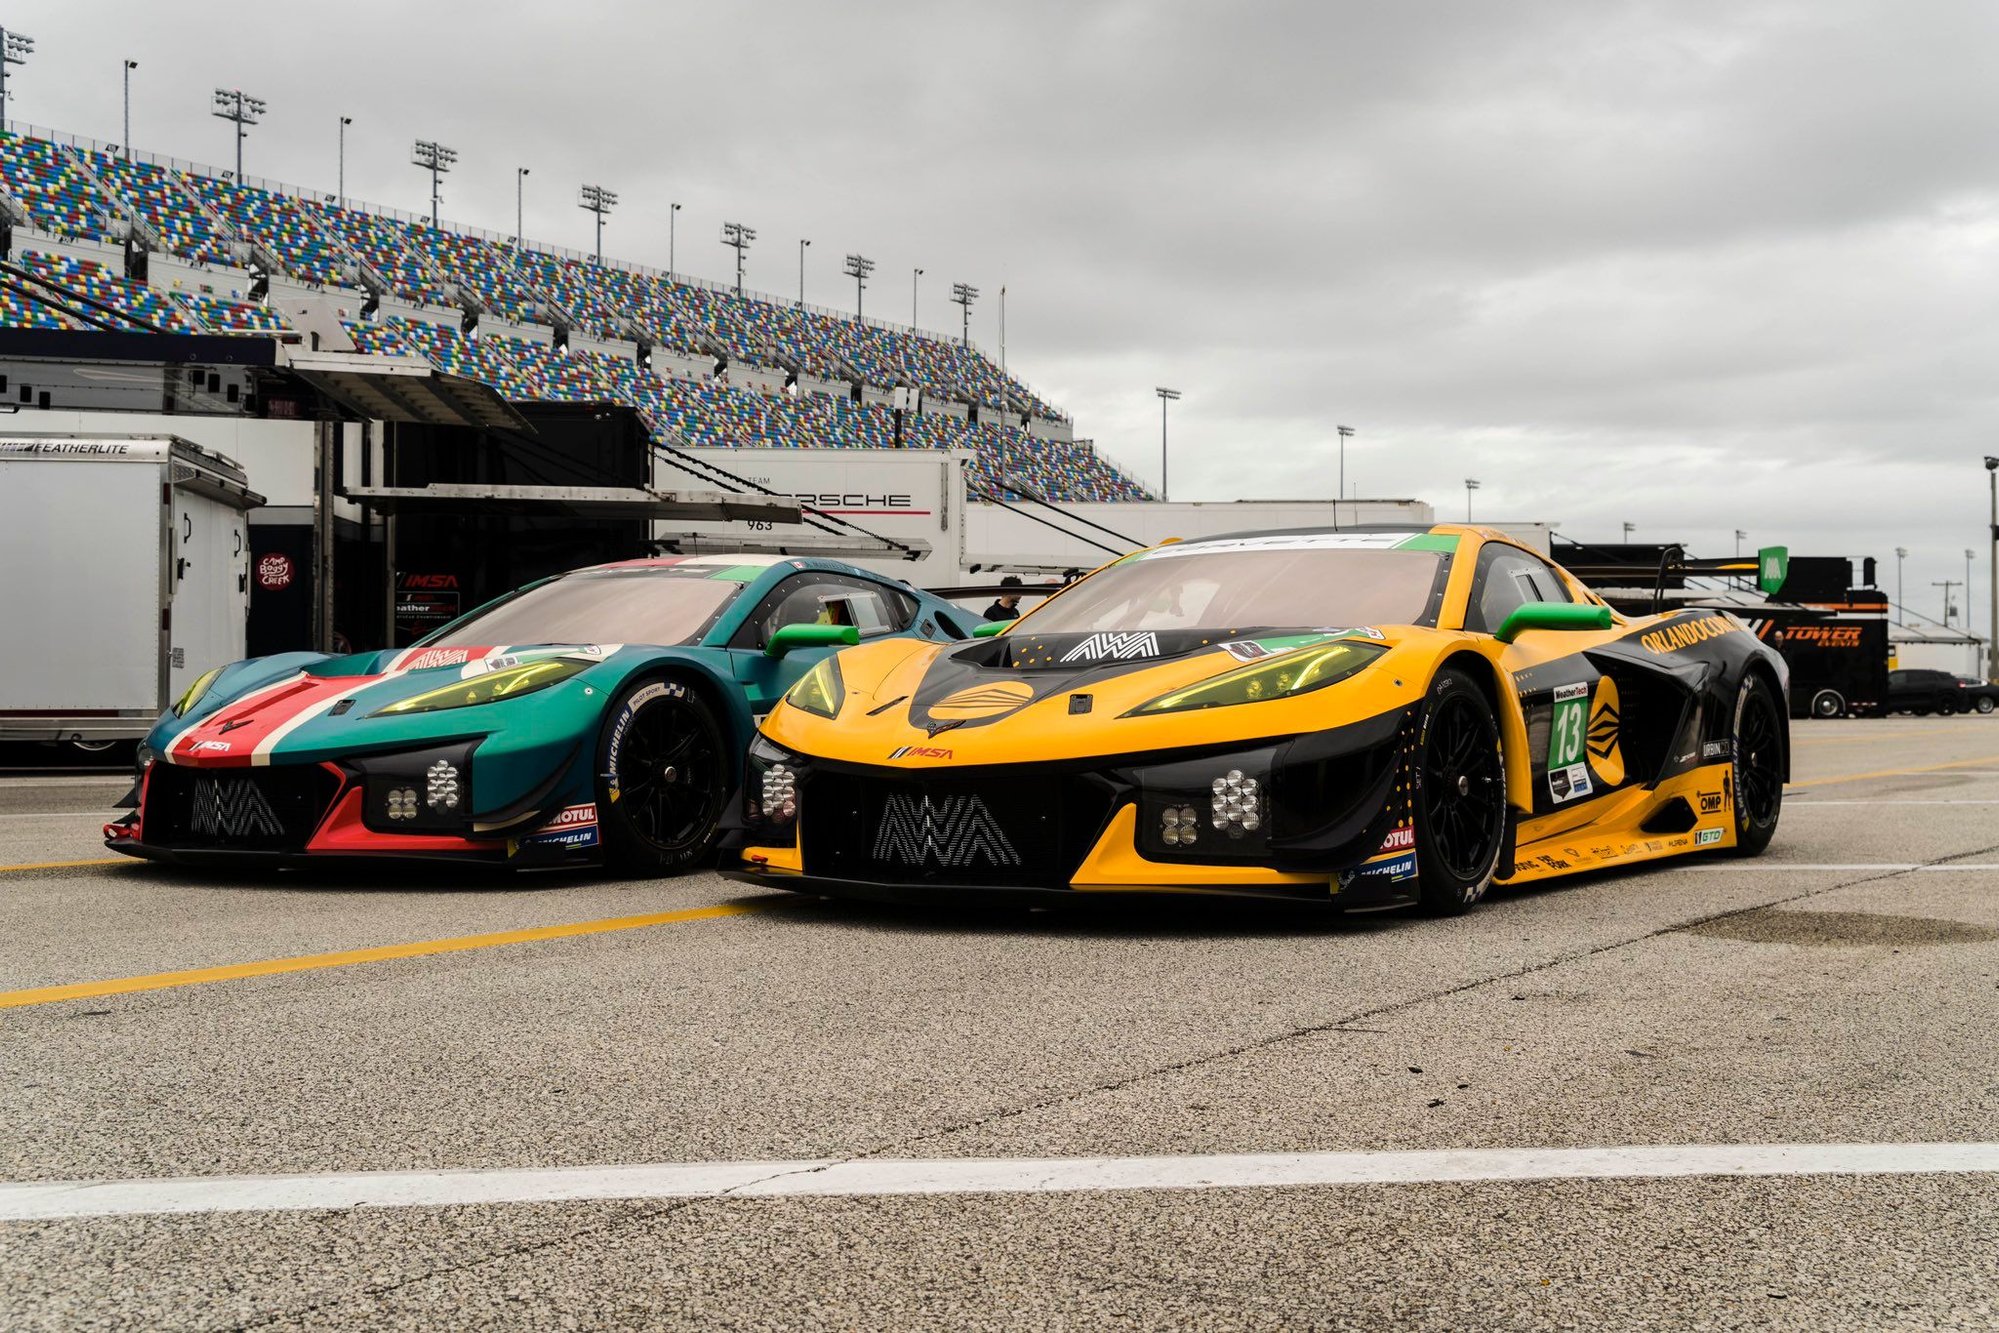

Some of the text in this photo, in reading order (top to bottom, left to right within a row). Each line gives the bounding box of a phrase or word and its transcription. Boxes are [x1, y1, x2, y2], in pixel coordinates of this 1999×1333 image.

[33, 443, 129, 454] FEATHERLITE
[748, 477, 770, 485] TEAM
[747, 520, 773, 531] 963
[405, 574, 459, 588] IMSA
[1785, 626, 1862, 640] TOWER
[1817, 639, 1861, 648] EVENTS
[645, 686, 661, 697] SPORT
[1555, 686, 1587, 700] WeatherTech
[1557, 702, 1582, 765] 13
[609, 709, 630, 777] MICHELIN
[907, 746, 954, 760] IMSA
[1700, 795, 1721, 810] OMP
[1380, 829, 1413, 850] OTUL
[1702, 830, 1721, 842] GTD
